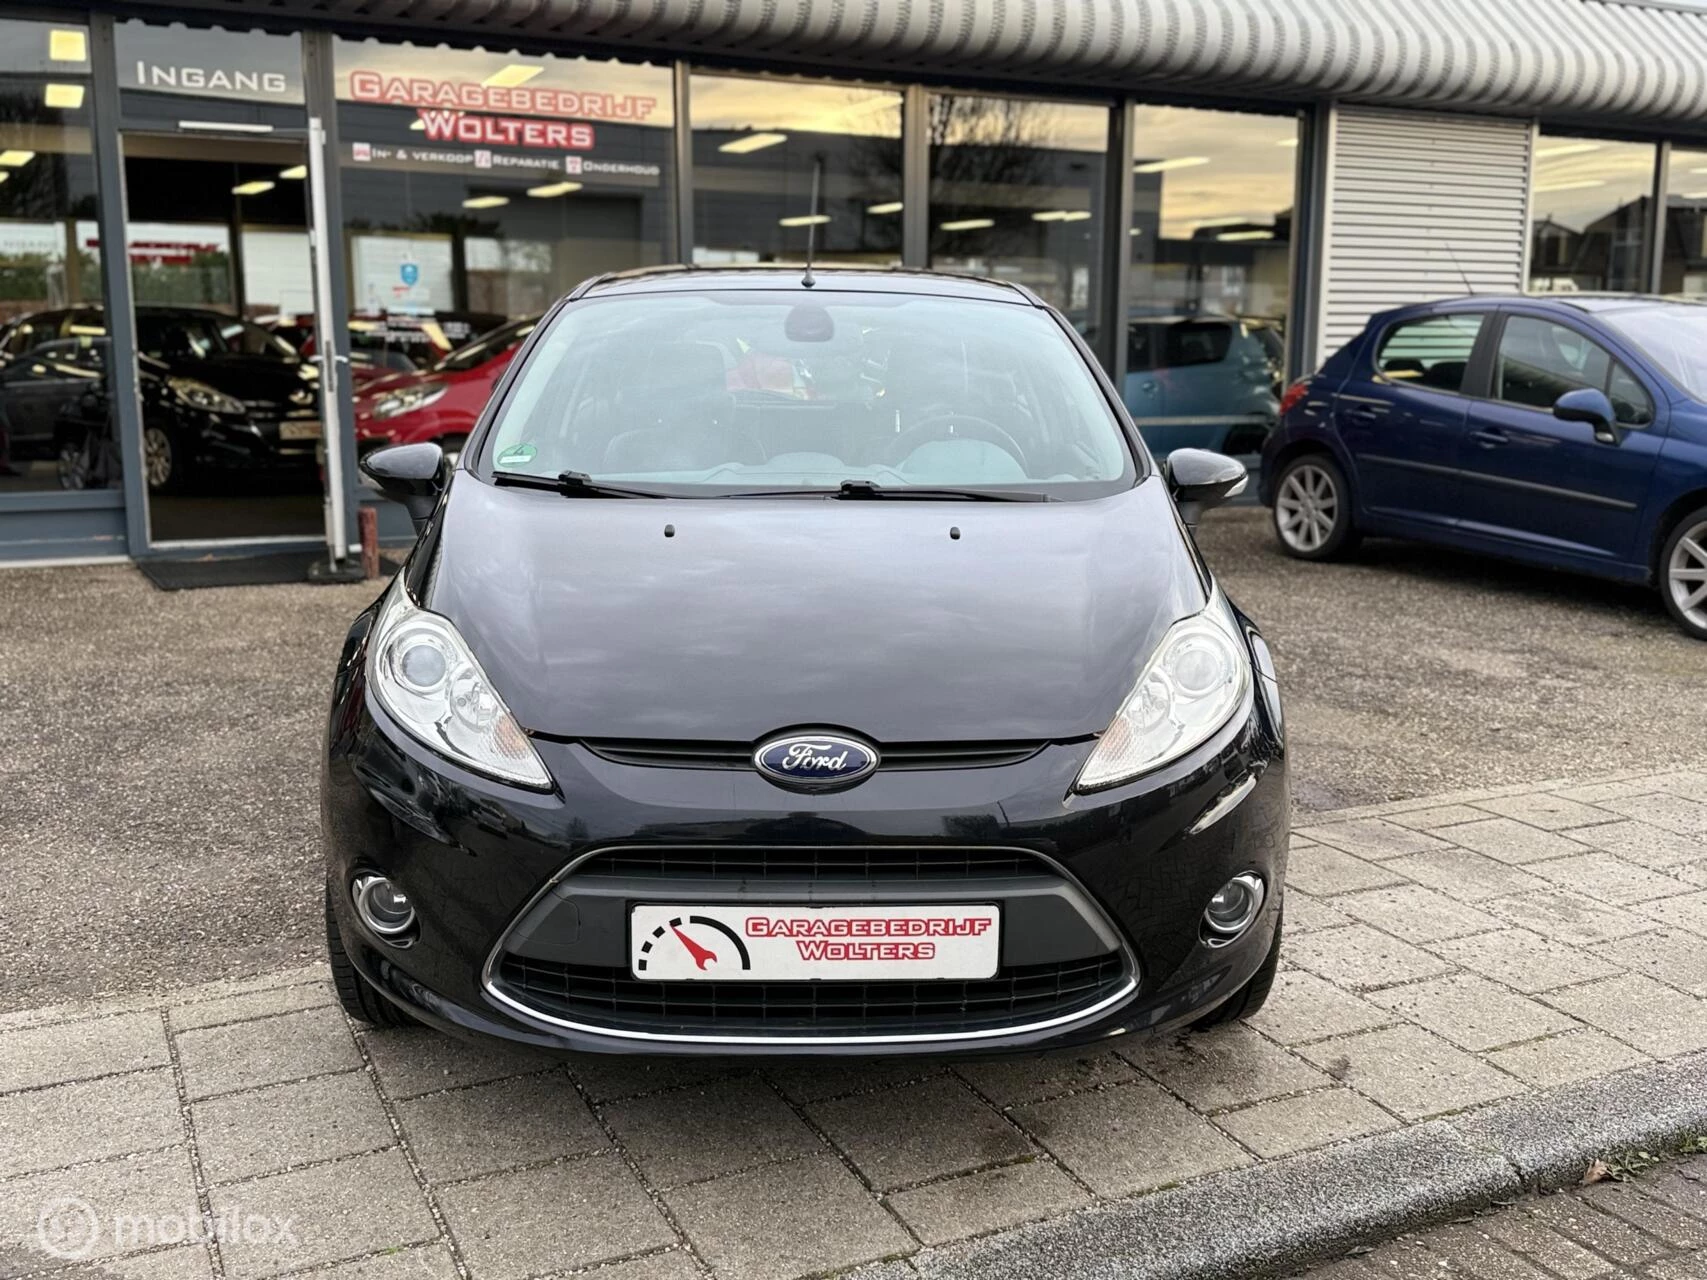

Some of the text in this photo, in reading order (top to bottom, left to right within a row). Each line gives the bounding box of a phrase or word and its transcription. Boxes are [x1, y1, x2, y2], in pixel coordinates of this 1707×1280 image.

[136, 60, 287, 93] INGANG
[350, 70, 658, 120] GARAGEBEDRIJF
[417, 108, 594, 150] WOLTERS
[396, 149, 408, 160] &
[492, 153, 560, 170] REPARATIE
[583, 160, 661, 176] ONDERHOUD
[781, 743, 848, 772] Ford
[745, 917, 992, 937] GARAGEBEDRIJF
[796, 940, 936, 961] WOLTERS
